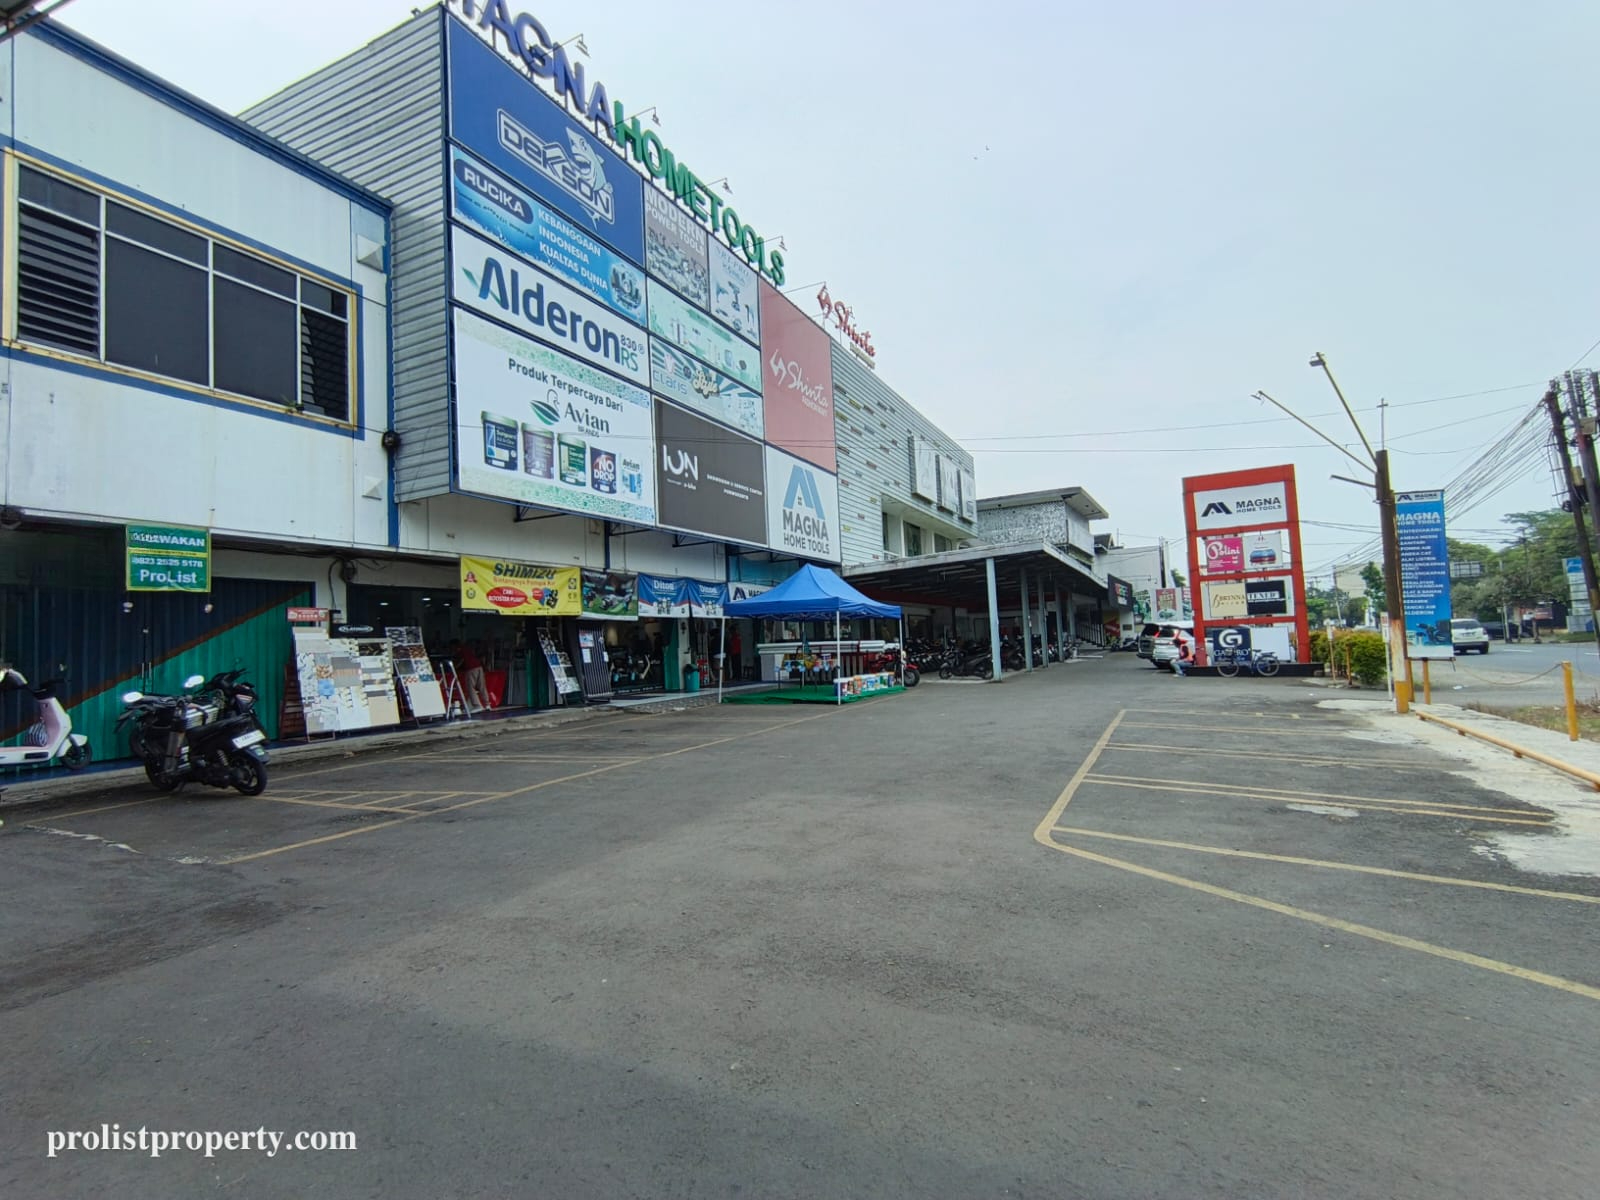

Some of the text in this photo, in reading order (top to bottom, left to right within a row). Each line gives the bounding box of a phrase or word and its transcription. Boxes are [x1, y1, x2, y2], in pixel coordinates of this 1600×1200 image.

[503, 120, 609, 217] DEKSON
[463, 167, 526, 217] RUCIKA
[538, 208, 601, 257] KEBANGGAAN
[647, 187, 704, 246] MODERN
[539, 226, 590, 264] INDONESIA
[580, 267, 609, 290] DUNIA
[479, 256, 620, 364] Alderon
[620, 334, 637, 351] 830
[621, 347, 639, 372] RS
[508, 358, 624, 413] Produk Terpercaya Dari
[787, 361, 829, 409] Shinta
[564, 402, 610, 434] Avian
[593, 469, 615, 482] DROP
[599, 457, 614, 472] NO
[1236, 497, 1281, 509] MAGNA
[783, 509, 829, 541] MAGNA
[784, 532, 830, 554] HOME TOOLS
[140, 569, 197, 584] ProList
[493, 562, 557, 580] SHIMIZU
